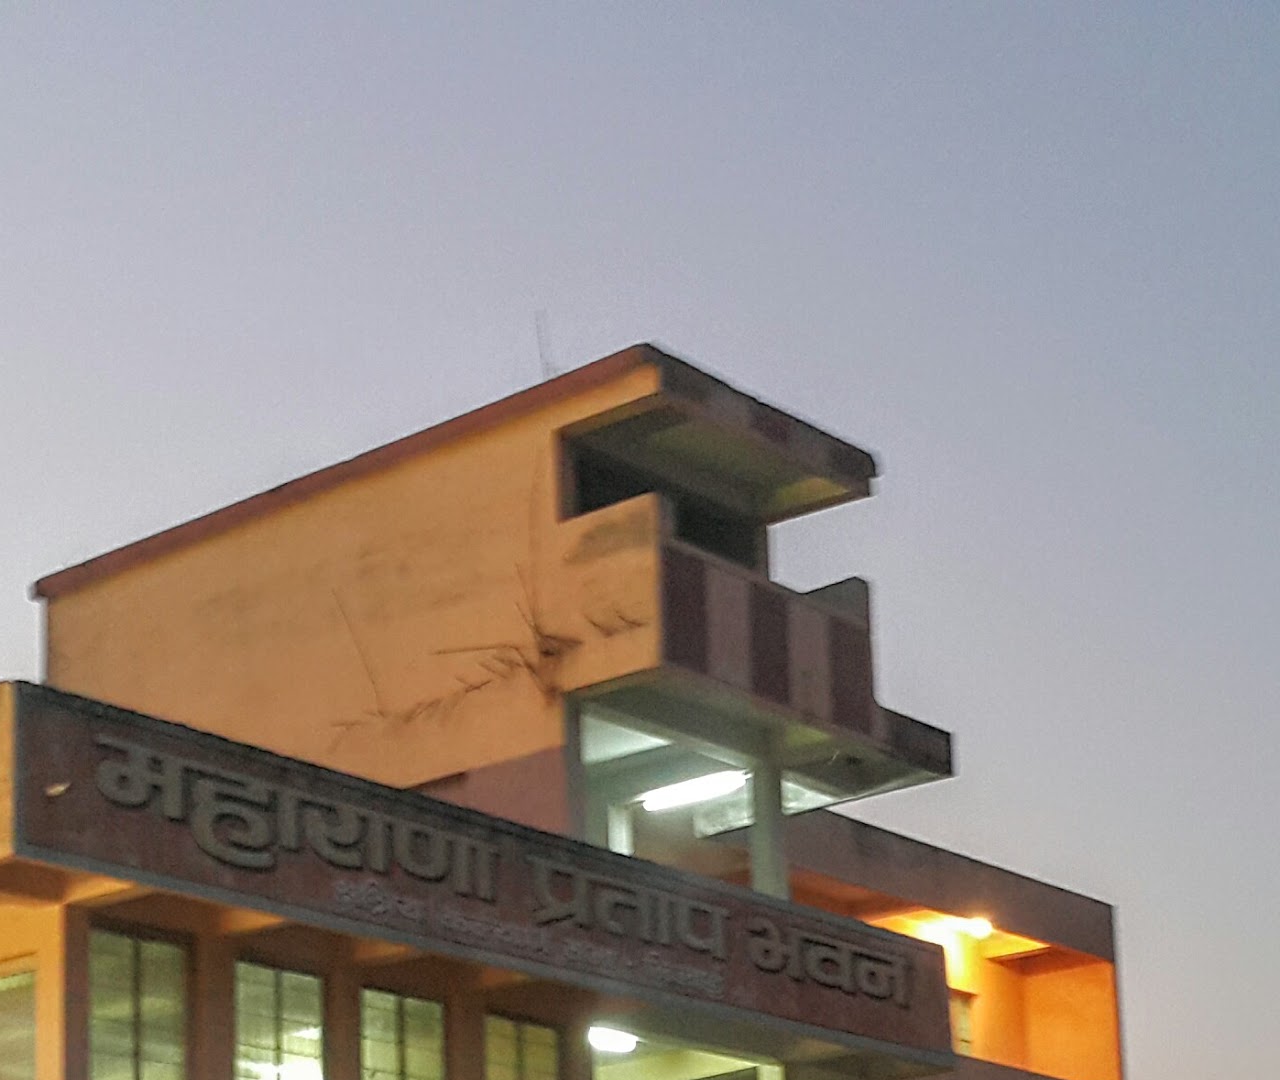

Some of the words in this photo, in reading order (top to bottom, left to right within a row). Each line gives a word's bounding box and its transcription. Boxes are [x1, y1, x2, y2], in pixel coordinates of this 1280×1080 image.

[95, 733, 501, 901] महाराणा
[528, 856, 730, 962] प्रताप
[747, 915, 916, 1010] भवन
